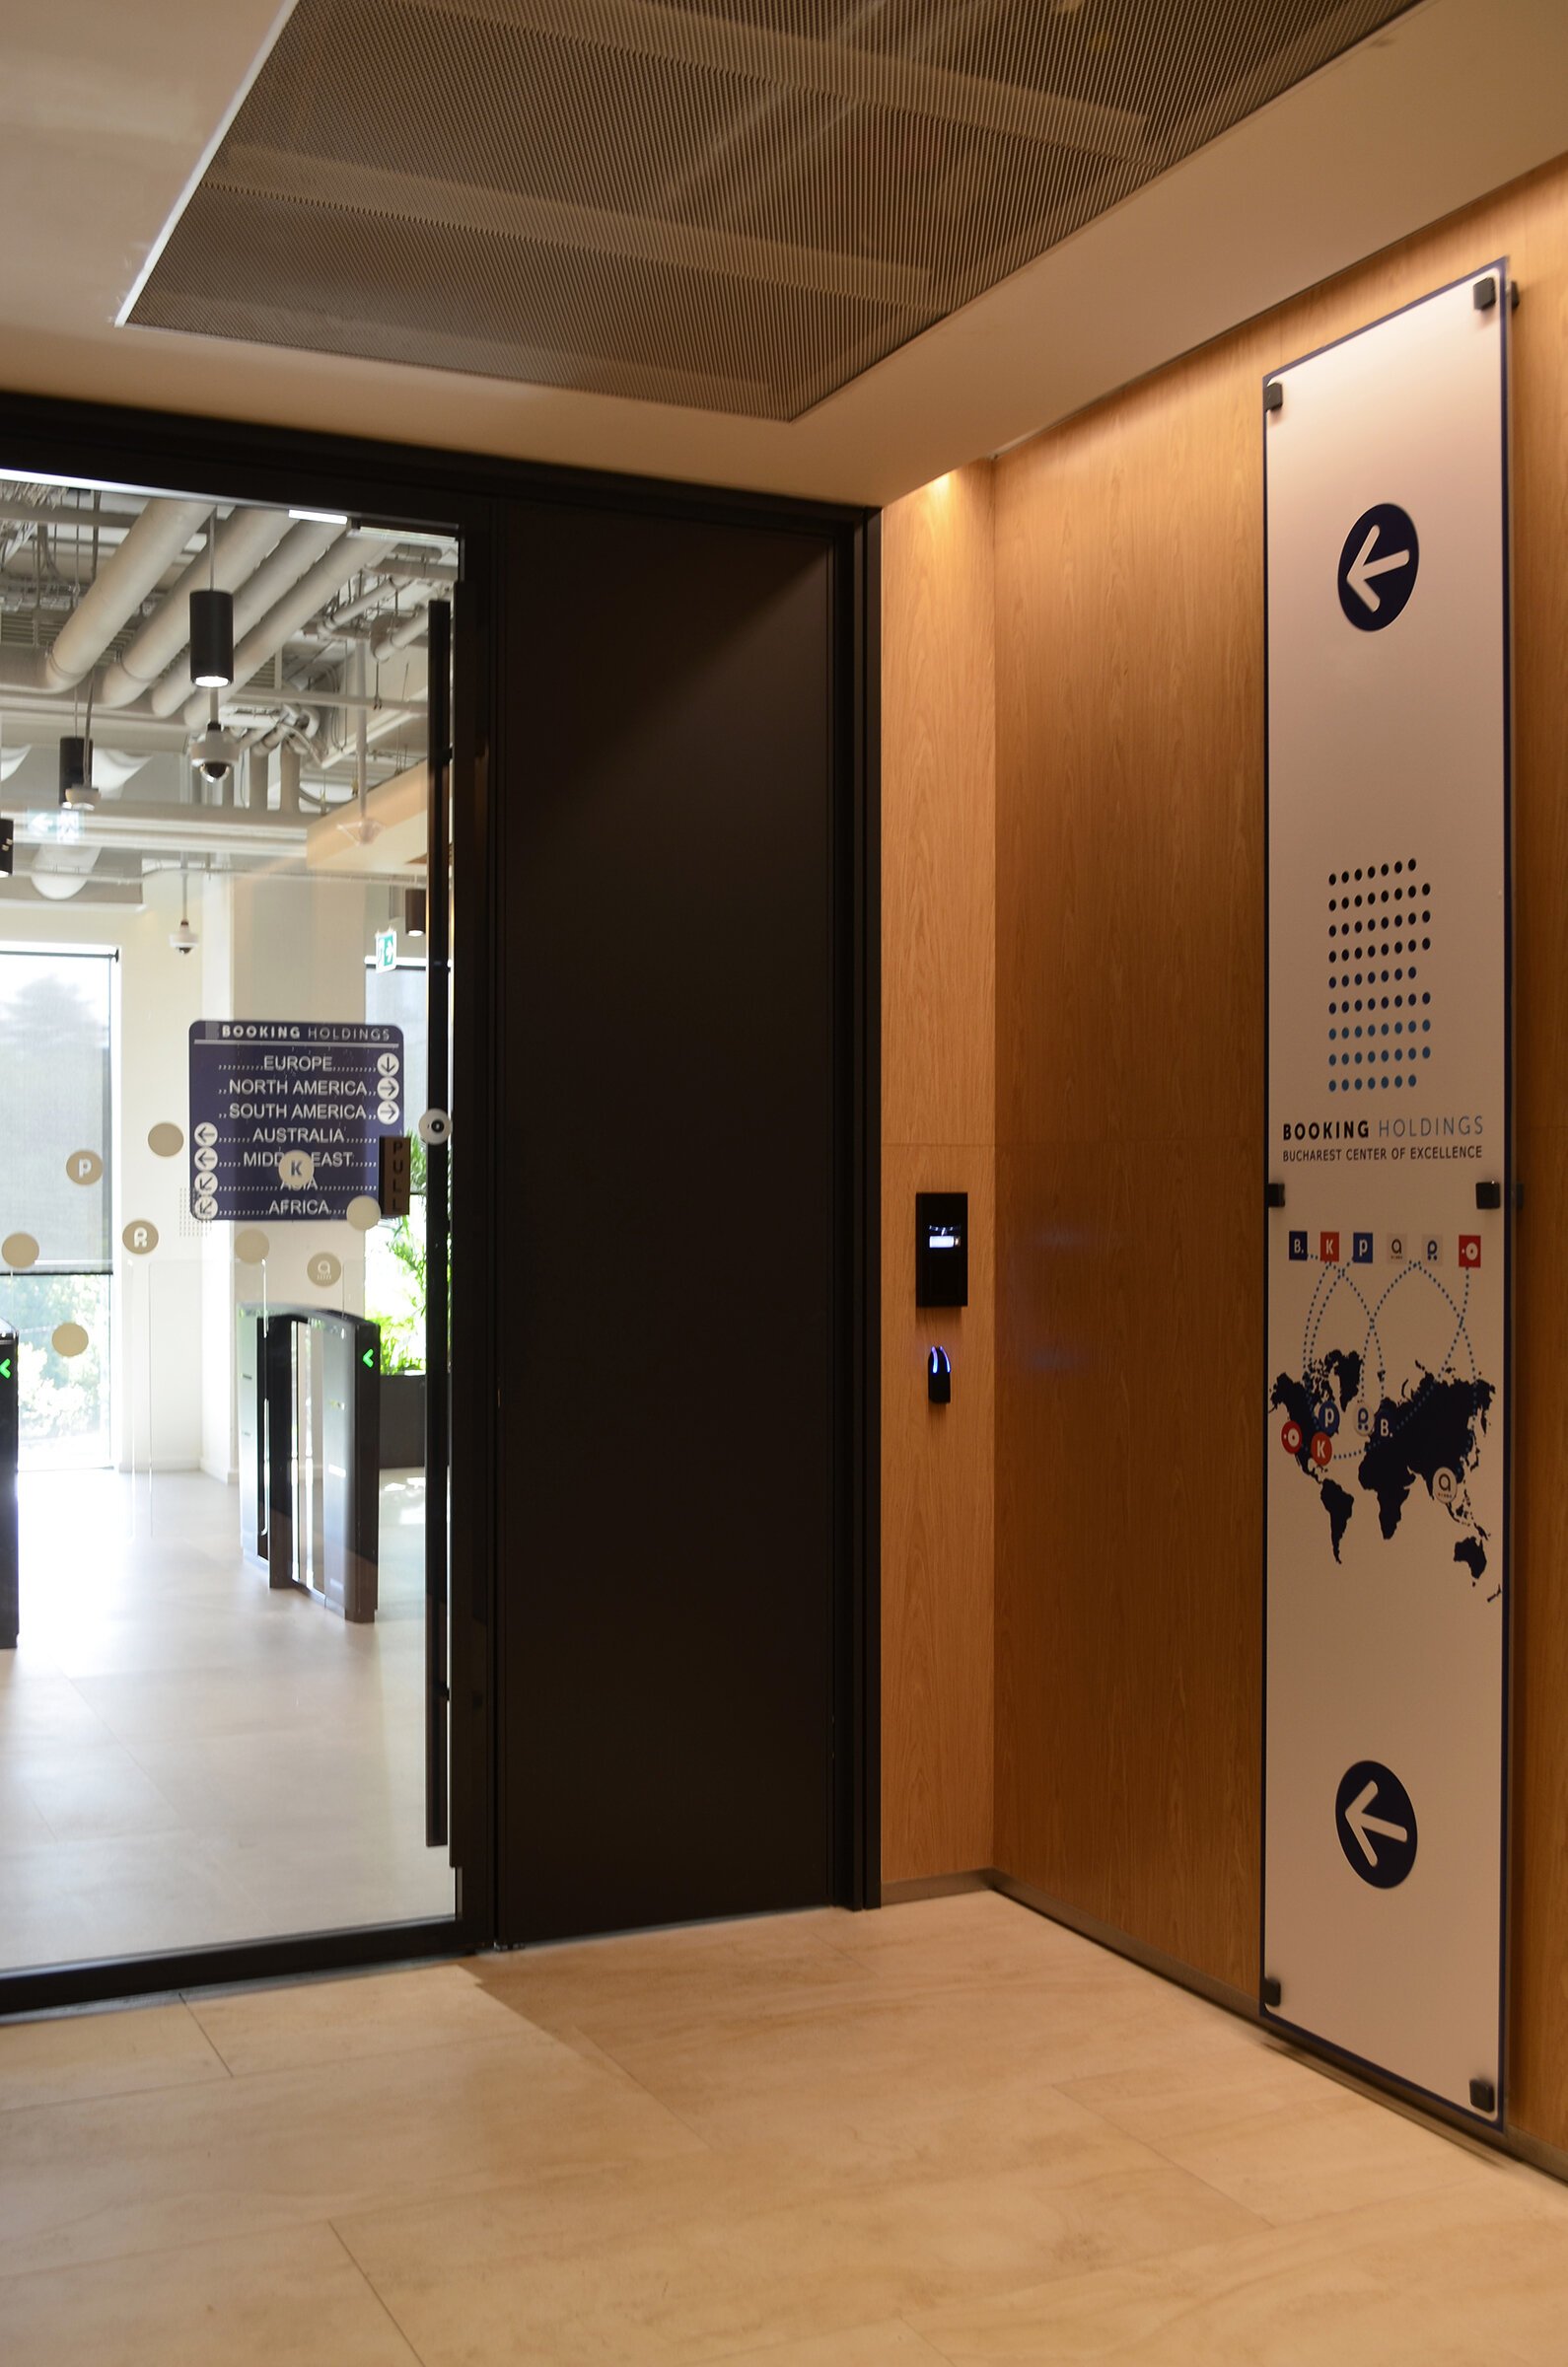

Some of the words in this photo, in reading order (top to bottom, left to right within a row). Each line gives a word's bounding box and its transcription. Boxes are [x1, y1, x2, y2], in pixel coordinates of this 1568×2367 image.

[222, 1025, 301, 1039] BOOKING
[308, 1027, 391, 1041] HOLDINGS
[263, 1055, 332, 1072] EUROPE
[229, 1079, 288, 1095] NORTH
[292, 1080, 368, 1096] AMERICA
[229, 1103, 287, 1119] SOUTH
[290, 1104, 367, 1119] AMERICA
[252, 1128, 344, 1143] AUSTRALIA
[1283, 1119, 1370, 1141] BOOKING
[1379, 1115, 1483, 1137] HOLDINGS
[243, 1151, 300, 1167] MIDD
[311, 1152, 353, 1167] EAST
[1283, 1148, 1343, 1162] BUCHAREST
[1345, 1147, 1388, 1162] CENTER
[1390, 1147, 1406, 1160] OF
[1409, 1144, 1483, 1161] EXCELLENCE
[291, 1161, 302, 1176] K
[268, 1199, 329, 1215] AFRICA
[1325, 1239, 1334, 1255] K
[1317, 1440, 1326, 1459] K
